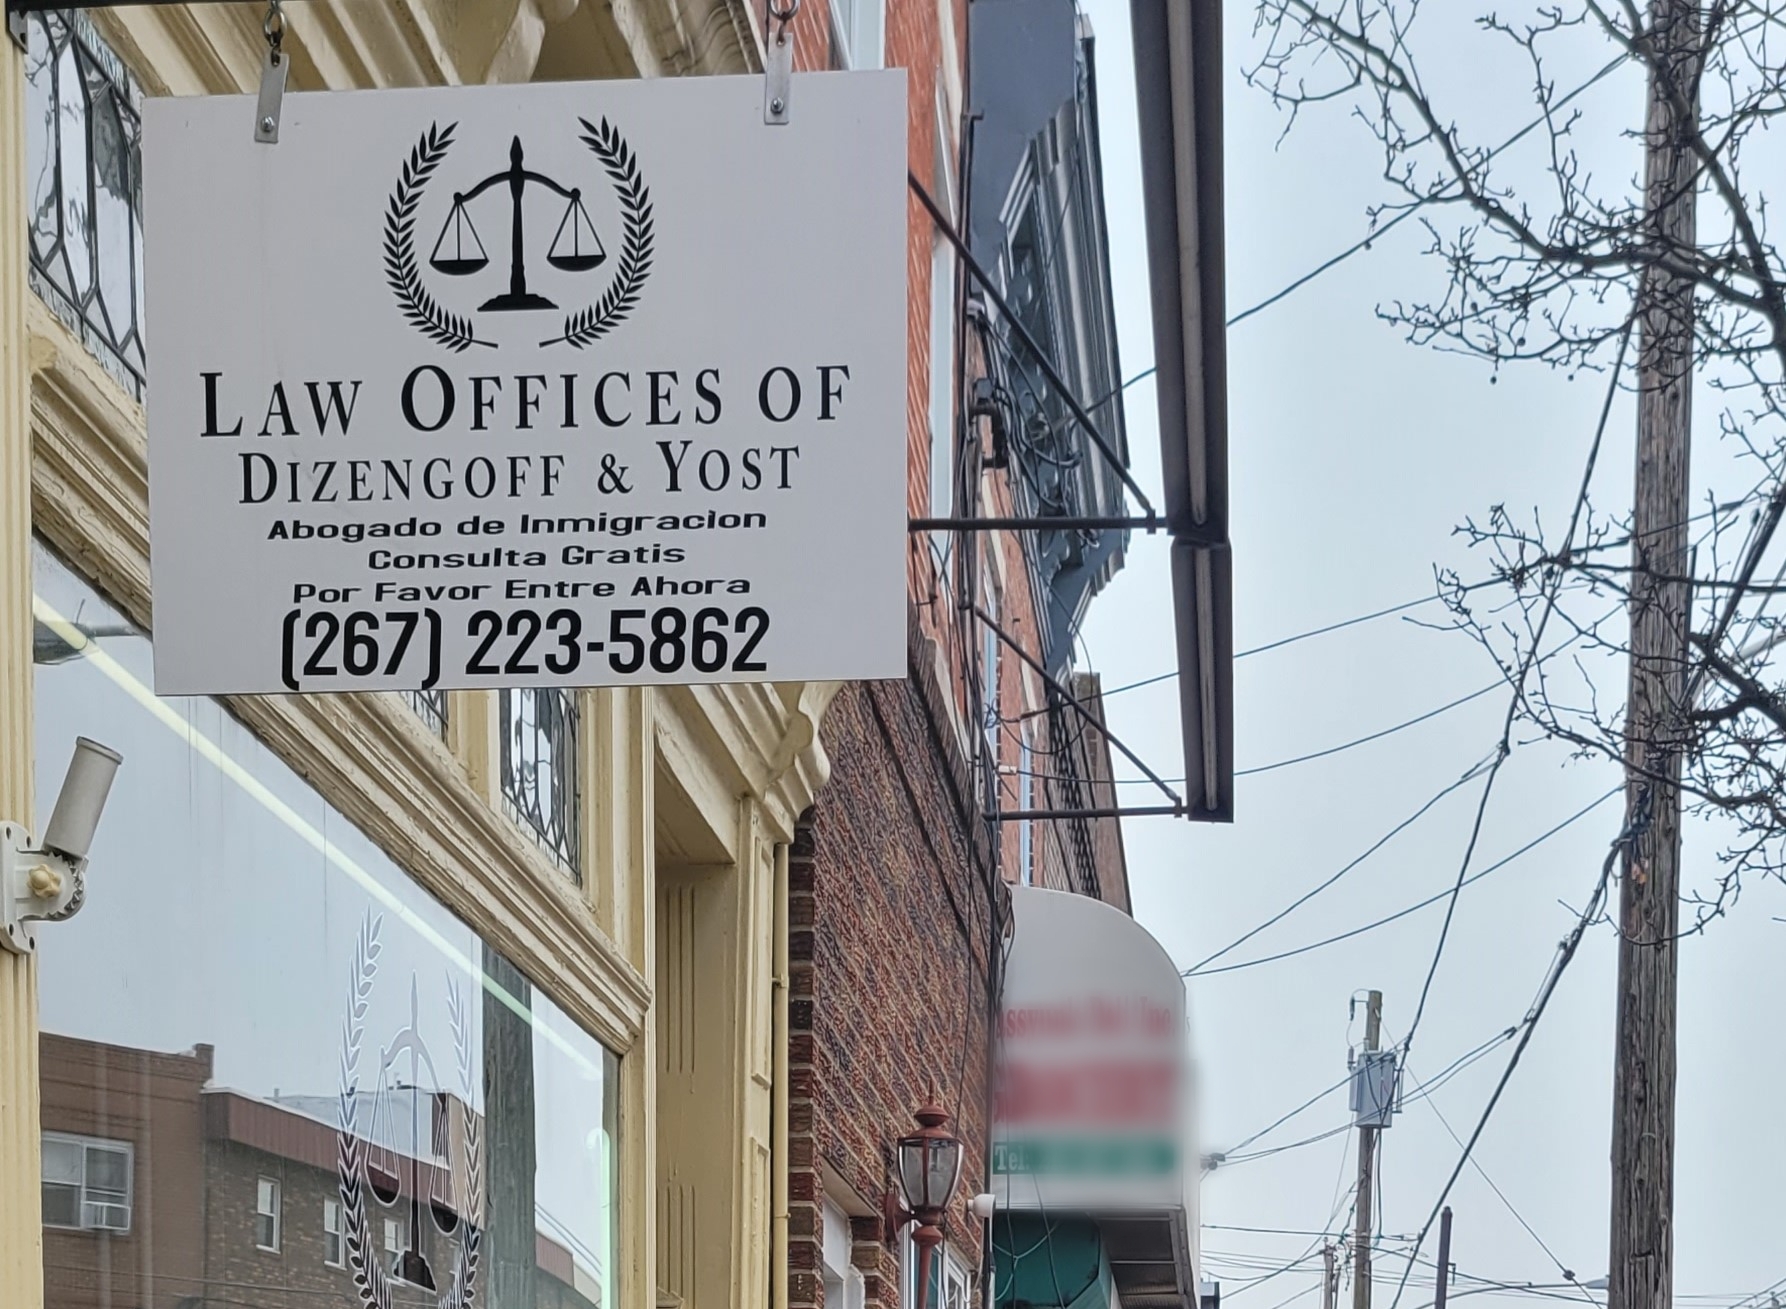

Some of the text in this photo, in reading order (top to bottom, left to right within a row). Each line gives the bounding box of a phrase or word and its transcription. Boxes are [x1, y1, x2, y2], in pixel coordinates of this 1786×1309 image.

[200, 365, 850, 437] LAW OFFICES OF
[239, 441, 800, 503] DIZENGOFF & YOST
[268, 518, 441, 543] Abogado
[458, 516, 505, 535] de
[369, 544, 686, 569] Consulta Gratis
[294, 576, 750, 603] Por Favor Entre Ahora
[282, 607, 770, 690] (267) 223-5862
